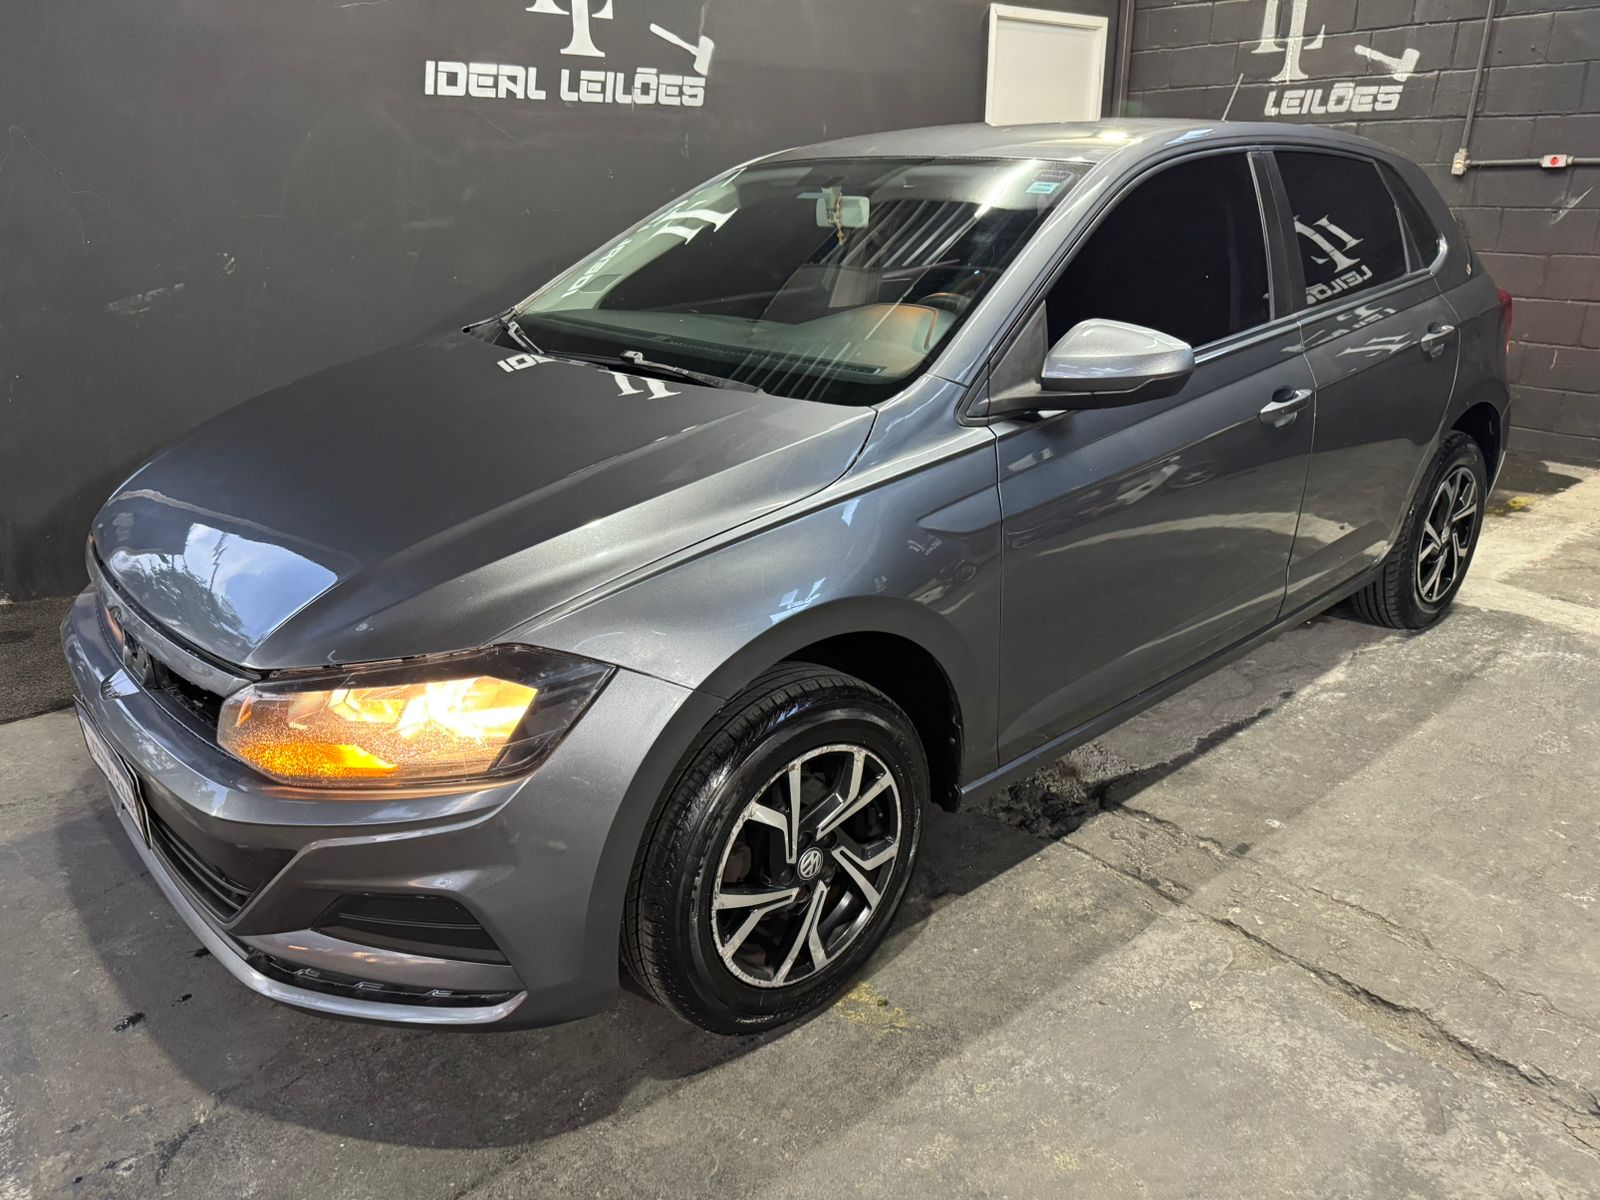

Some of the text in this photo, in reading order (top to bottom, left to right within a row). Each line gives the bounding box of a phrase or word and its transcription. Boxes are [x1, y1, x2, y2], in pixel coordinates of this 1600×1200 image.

[424, 60, 706, 107] IDEAL LEILÕES
[1264, 82, 1403, 117] LEILÕES
